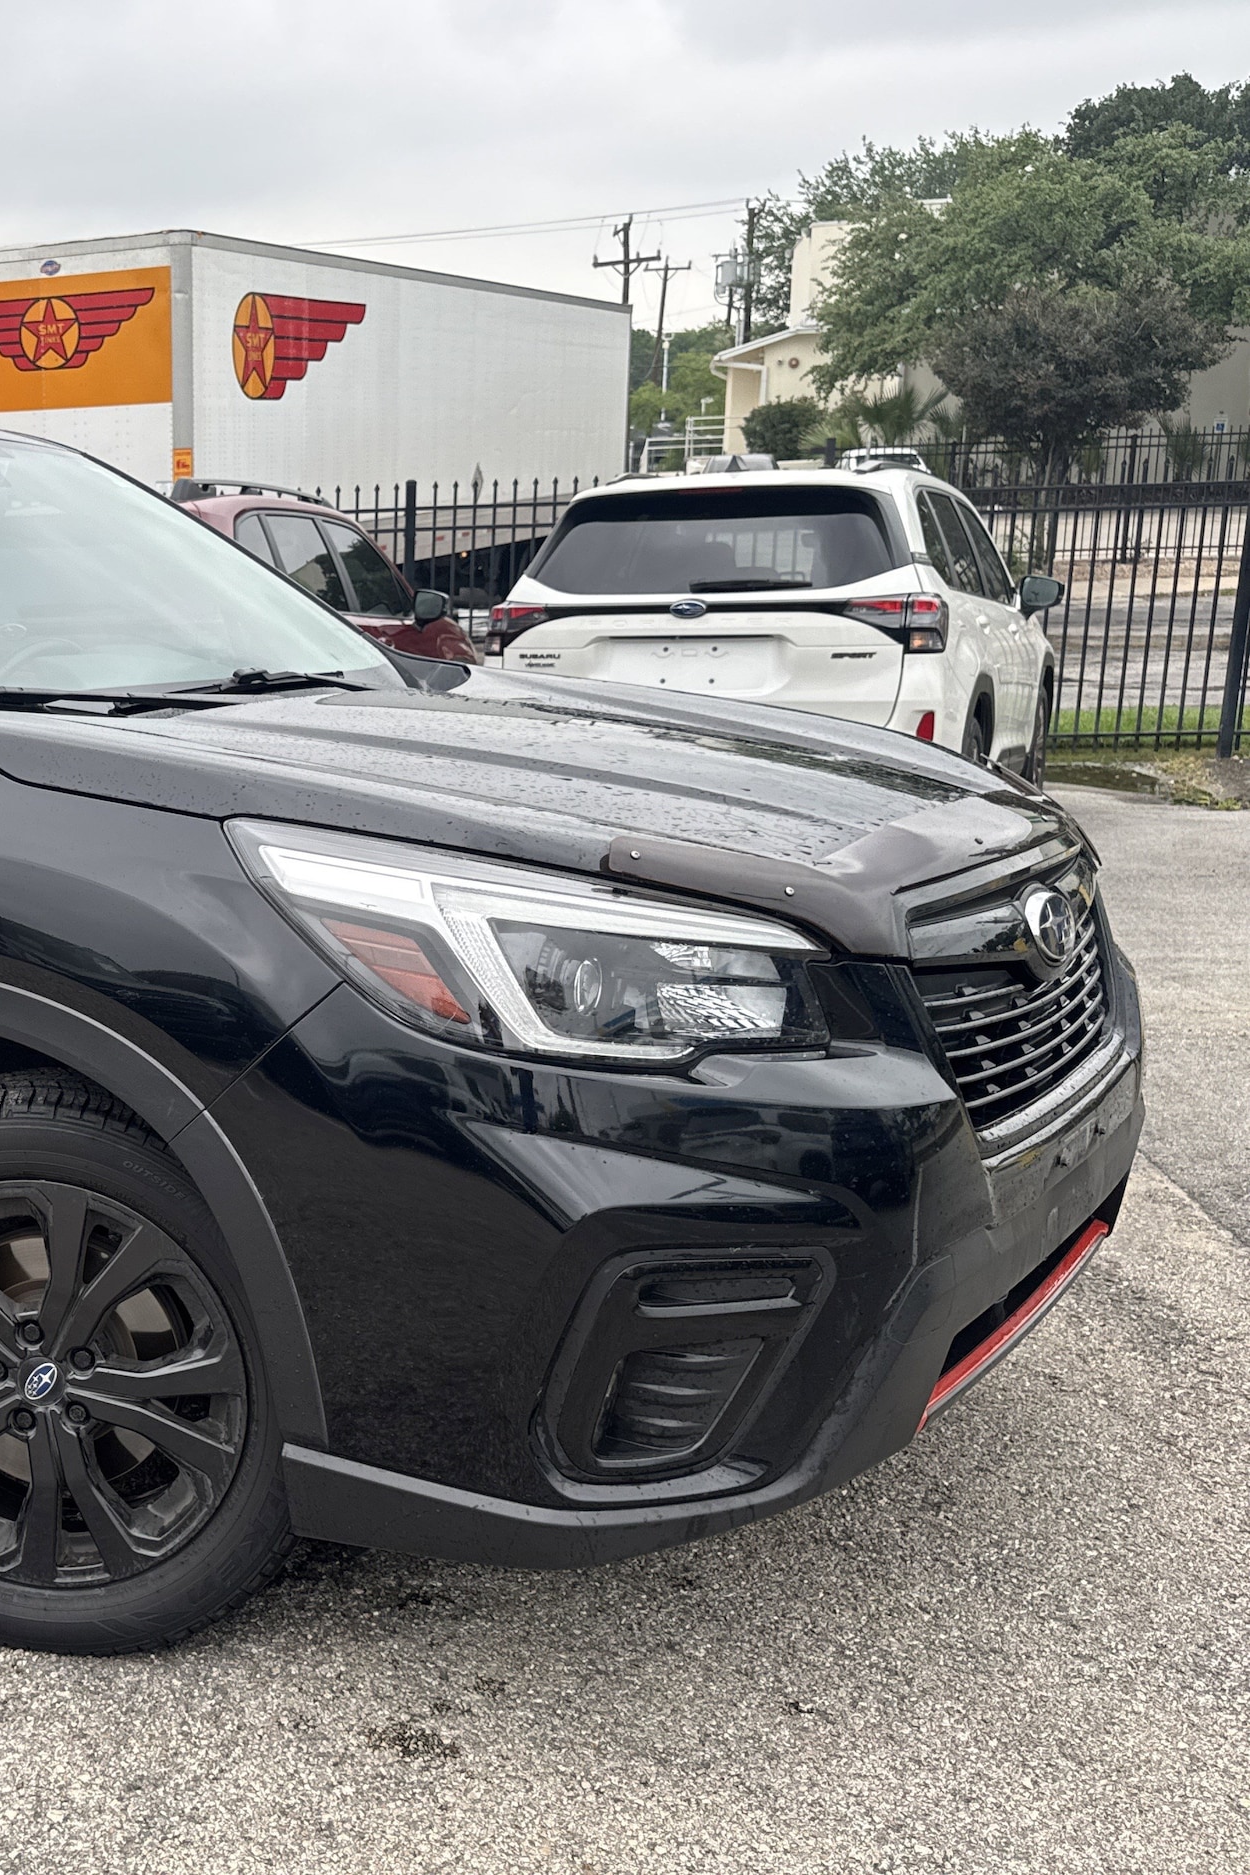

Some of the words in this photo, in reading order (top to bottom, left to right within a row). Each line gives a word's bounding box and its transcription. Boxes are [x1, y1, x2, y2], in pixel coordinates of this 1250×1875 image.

[38, 323, 65, 335] SMT
[246, 332, 265, 348] SMT
[830, 651, 877, 660] SPORT
[122, 1160, 187, 1200] OUTSIDE
